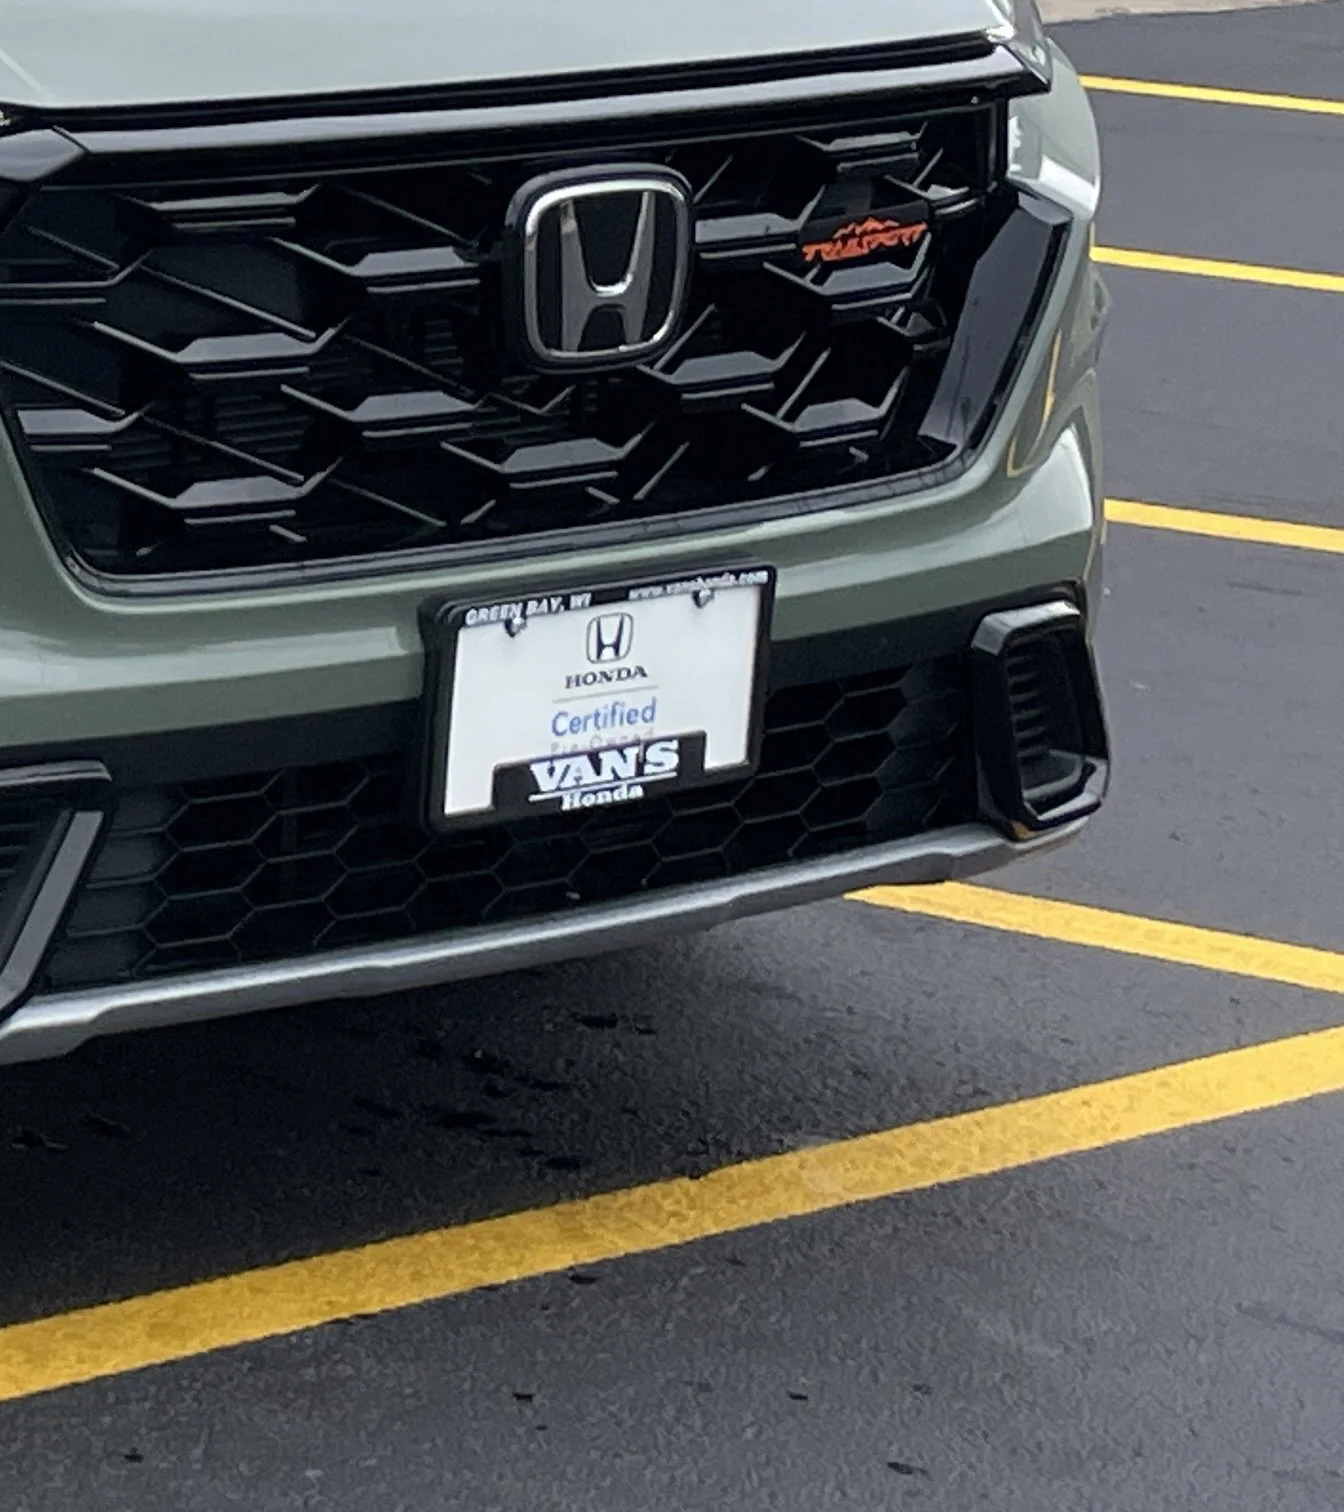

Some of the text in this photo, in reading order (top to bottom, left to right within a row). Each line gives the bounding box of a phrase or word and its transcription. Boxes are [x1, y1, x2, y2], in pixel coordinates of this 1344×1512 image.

[564, 665, 648, 689] HONDA
[551, 695, 657, 737] Certified
[561, 783, 645, 811] Honda
